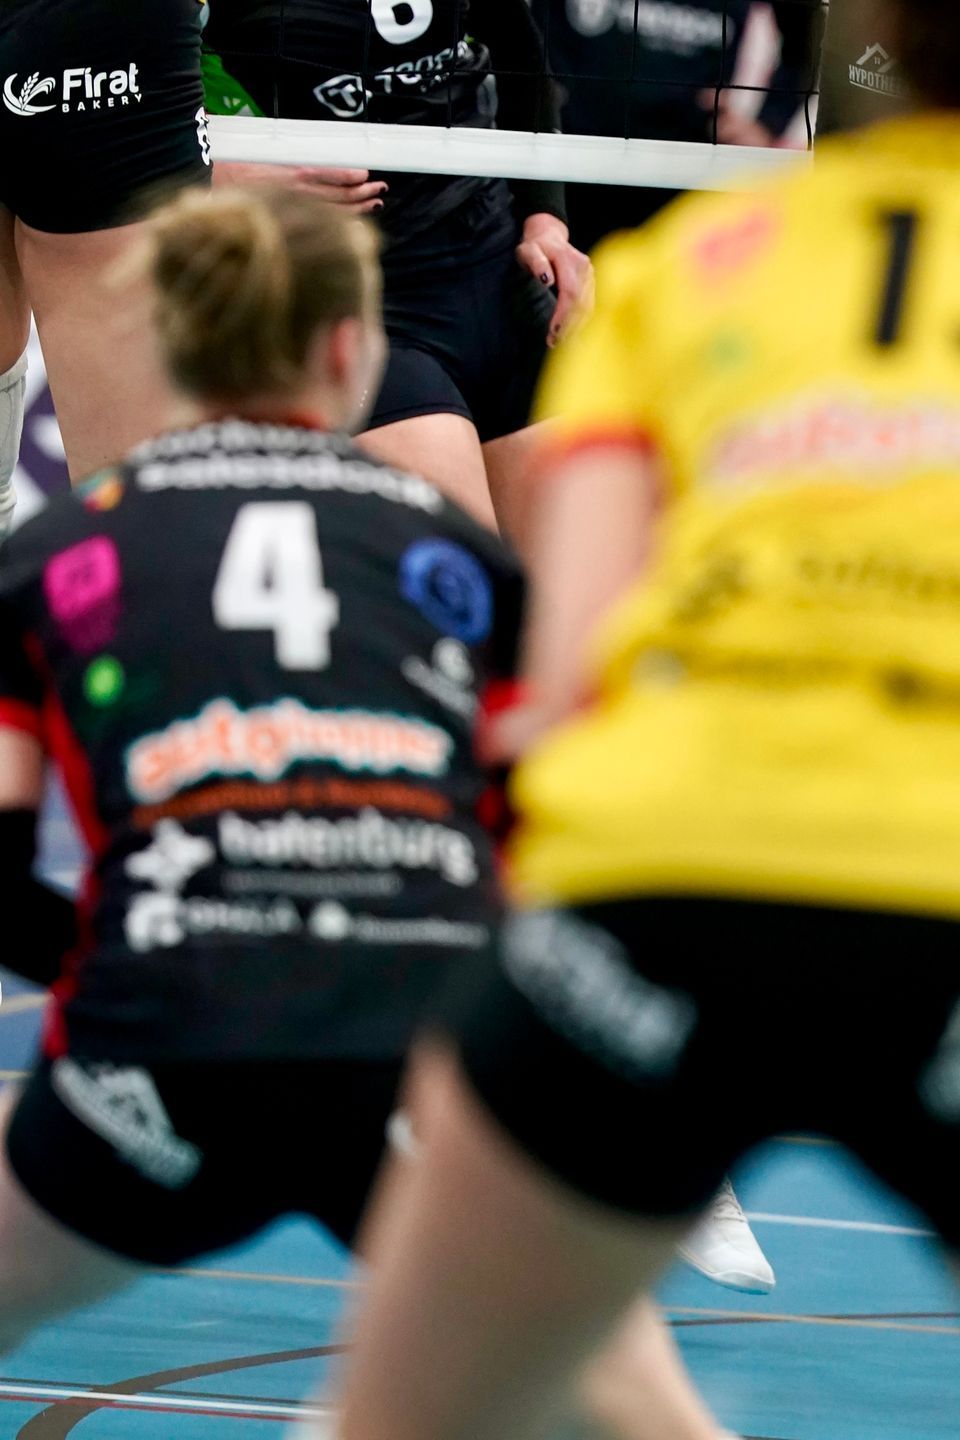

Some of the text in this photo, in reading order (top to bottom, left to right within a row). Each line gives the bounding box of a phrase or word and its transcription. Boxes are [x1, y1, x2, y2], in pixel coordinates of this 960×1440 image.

[62, 62, 140, 101] Firat
[61, 93, 143, 113] BAKERY
[211, 500, 340, 672] 4
